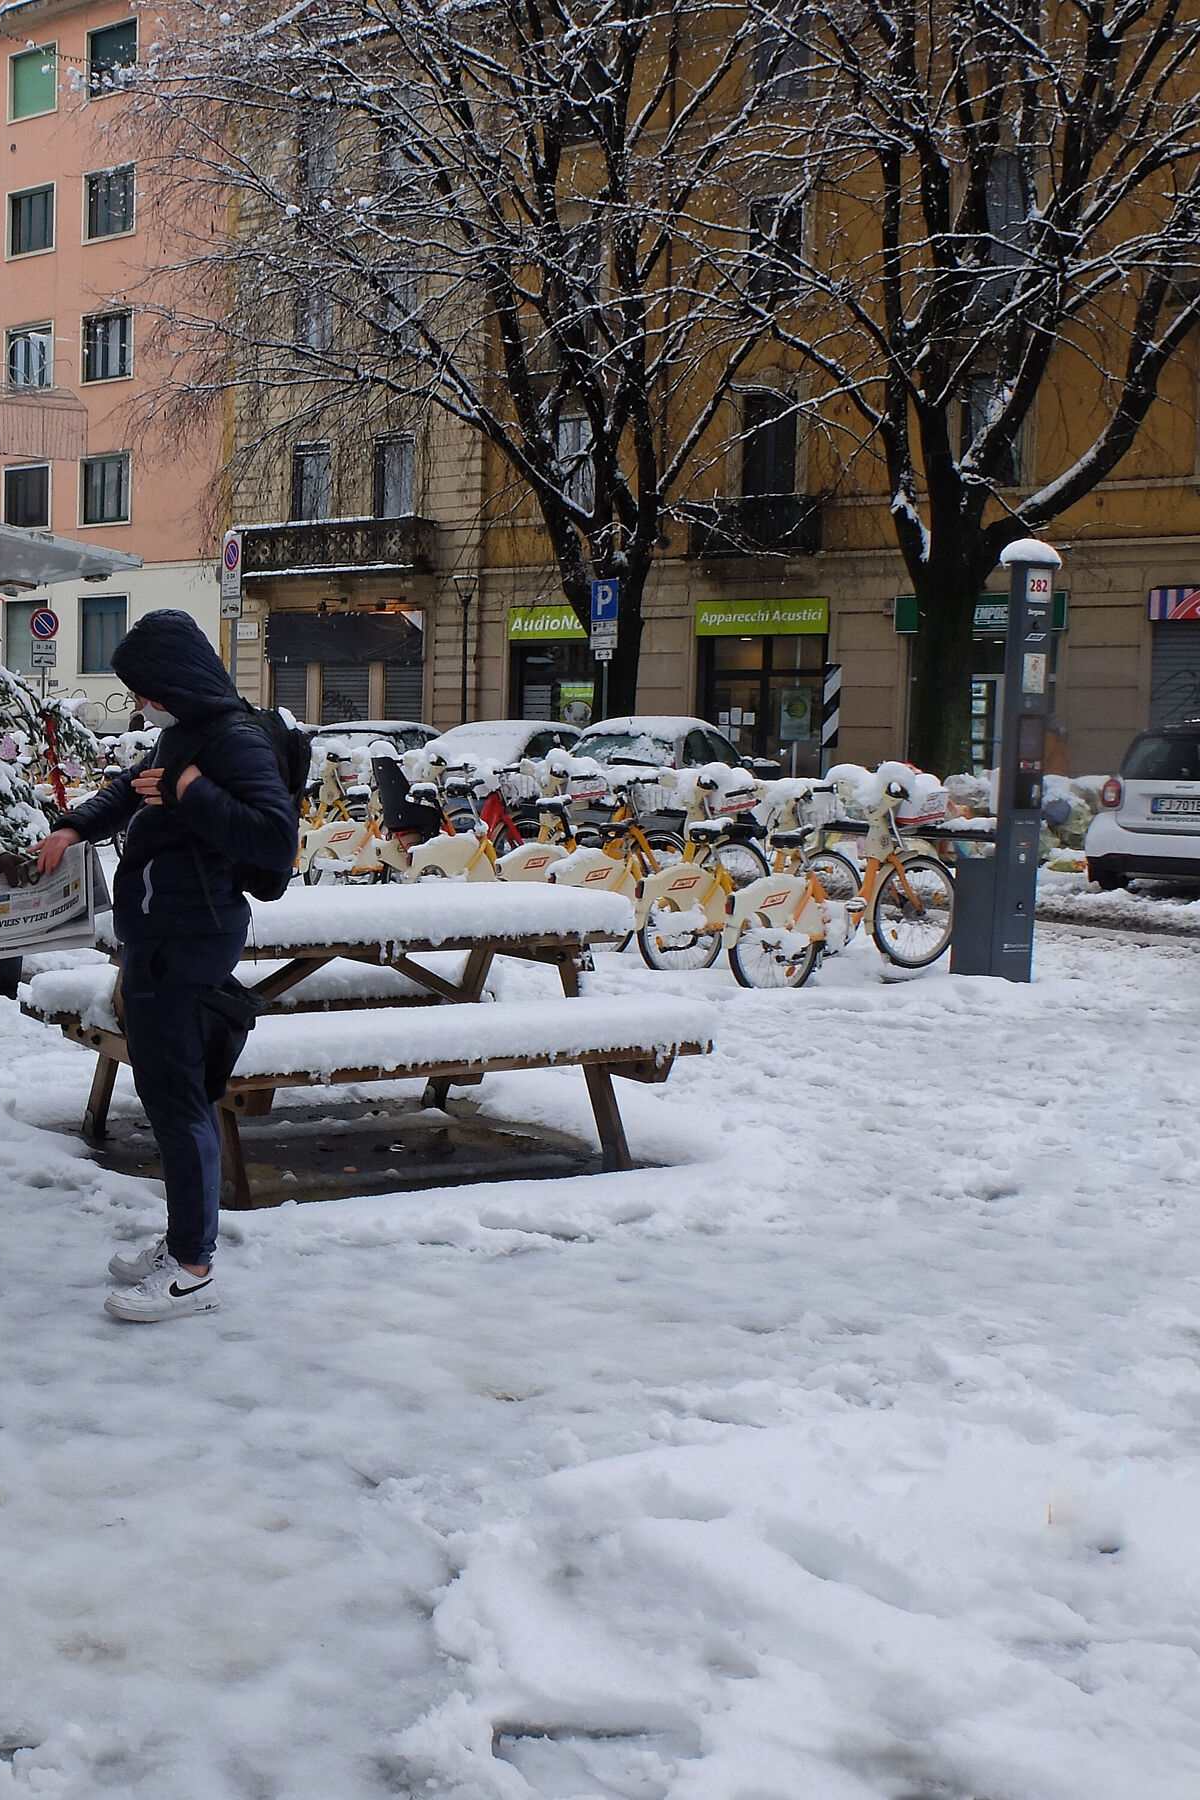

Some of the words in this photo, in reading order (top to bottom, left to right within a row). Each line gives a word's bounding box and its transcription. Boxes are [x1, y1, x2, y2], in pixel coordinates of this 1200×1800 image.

[1029, 579, 1048, 593] 282
[597, 584, 613, 616] P
[700, 609, 770, 626] Apparecchi
[771, 608, 824, 622] Acustici
[973, 606, 1008, 620] EMPOC
[510, 614, 584, 633] AudioNo
[49, 894, 80, 918] CORRIERE
[22, 911, 49, 924] DELLA
